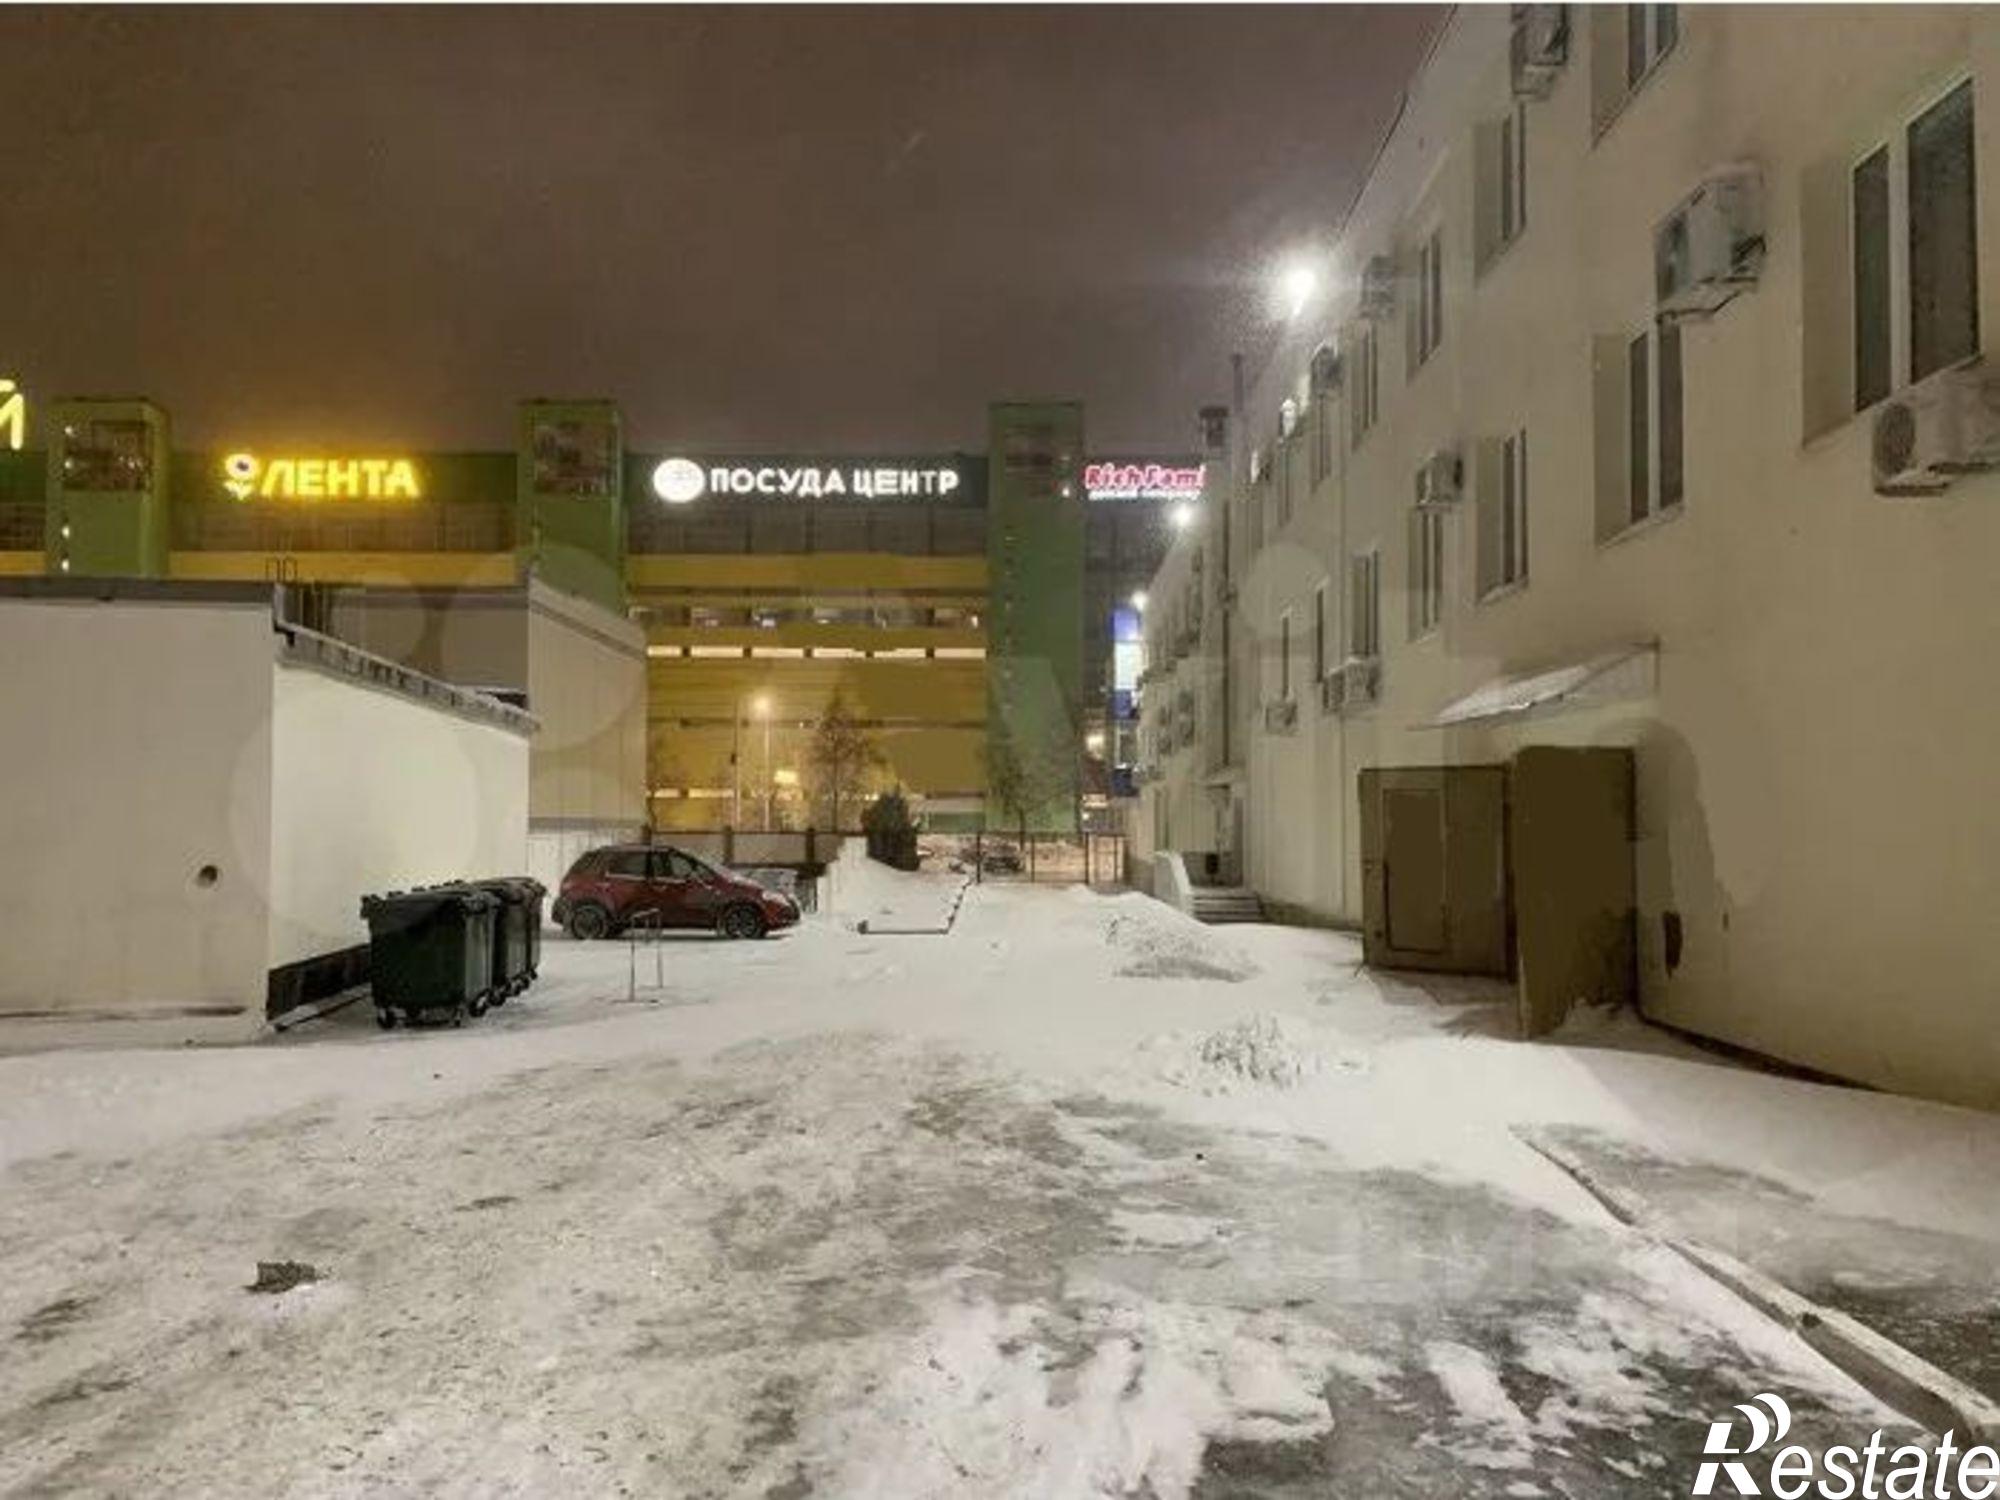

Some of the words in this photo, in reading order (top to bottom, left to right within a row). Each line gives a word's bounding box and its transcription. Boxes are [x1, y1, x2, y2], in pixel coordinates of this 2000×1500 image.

[261, 459, 420, 498] ЛЕНТА
[710, 467, 847, 498] ПОСУДА
[853, 469, 959, 498] ЦЕНТР
[1085, 463, 1145, 490] Rich
